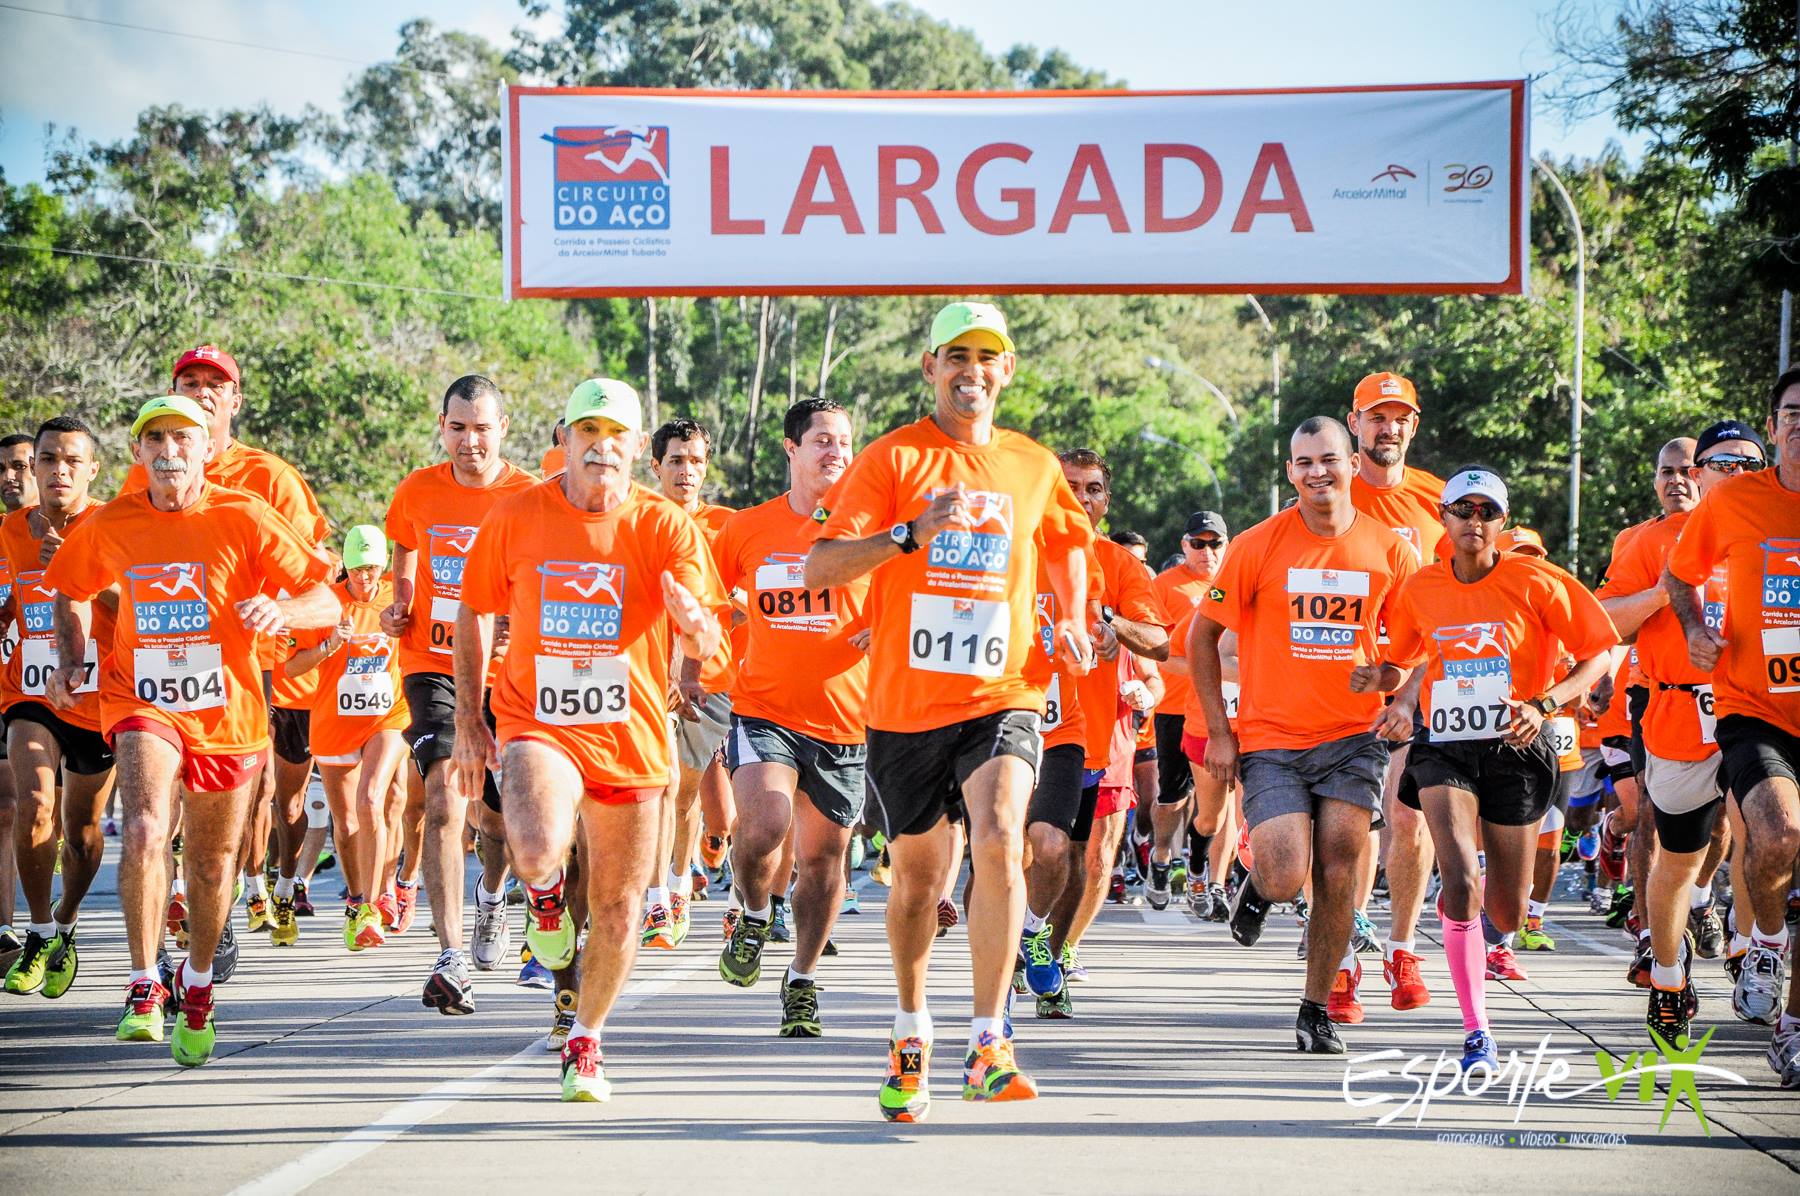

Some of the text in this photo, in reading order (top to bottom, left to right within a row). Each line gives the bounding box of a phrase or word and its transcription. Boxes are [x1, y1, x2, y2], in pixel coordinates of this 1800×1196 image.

[557, 186, 666, 202] CIRCUITO
[710, 142, 1315, 236] LARGADA
[1332, 188, 1407, 199] ArcelorMittal
[558, 204, 666, 228] DO AÇO
[553, 237, 586, 246] Corrida
[597, 237, 631, 246] Passeio
[572, 247, 629, 257] ArcelorMittal
[631, 247, 667, 257] Tubarão
[932, 534, 1009, 552] CIRCUITO
[931, 547, 1007, 570] DO AÇO
[758, 588, 831, 615] 0811
[1765, 590, 1791, 604] DO
[136, 603, 205, 616] CIRCUITO
[543, 604, 619, 620] CIRCUITO
[1291, 595, 1363, 622] 1021
[26, 617, 43, 629] DO
[137, 615, 206, 631] DO AÇO
[543, 617, 617, 638] DO AÇO
[1292, 627, 1353, 644] DO AÇO
[913, 628, 1004, 667] 0116
[24, 662, 96, 688] 007
[1446, 659, 1507, 673] CIRCUITO
[138, 672, 222, 703] 0504
[339, 692, 392, 710] 0549
[539, 684, 626, 716] 0503
[1432, 704, 1508, 734] 0307
